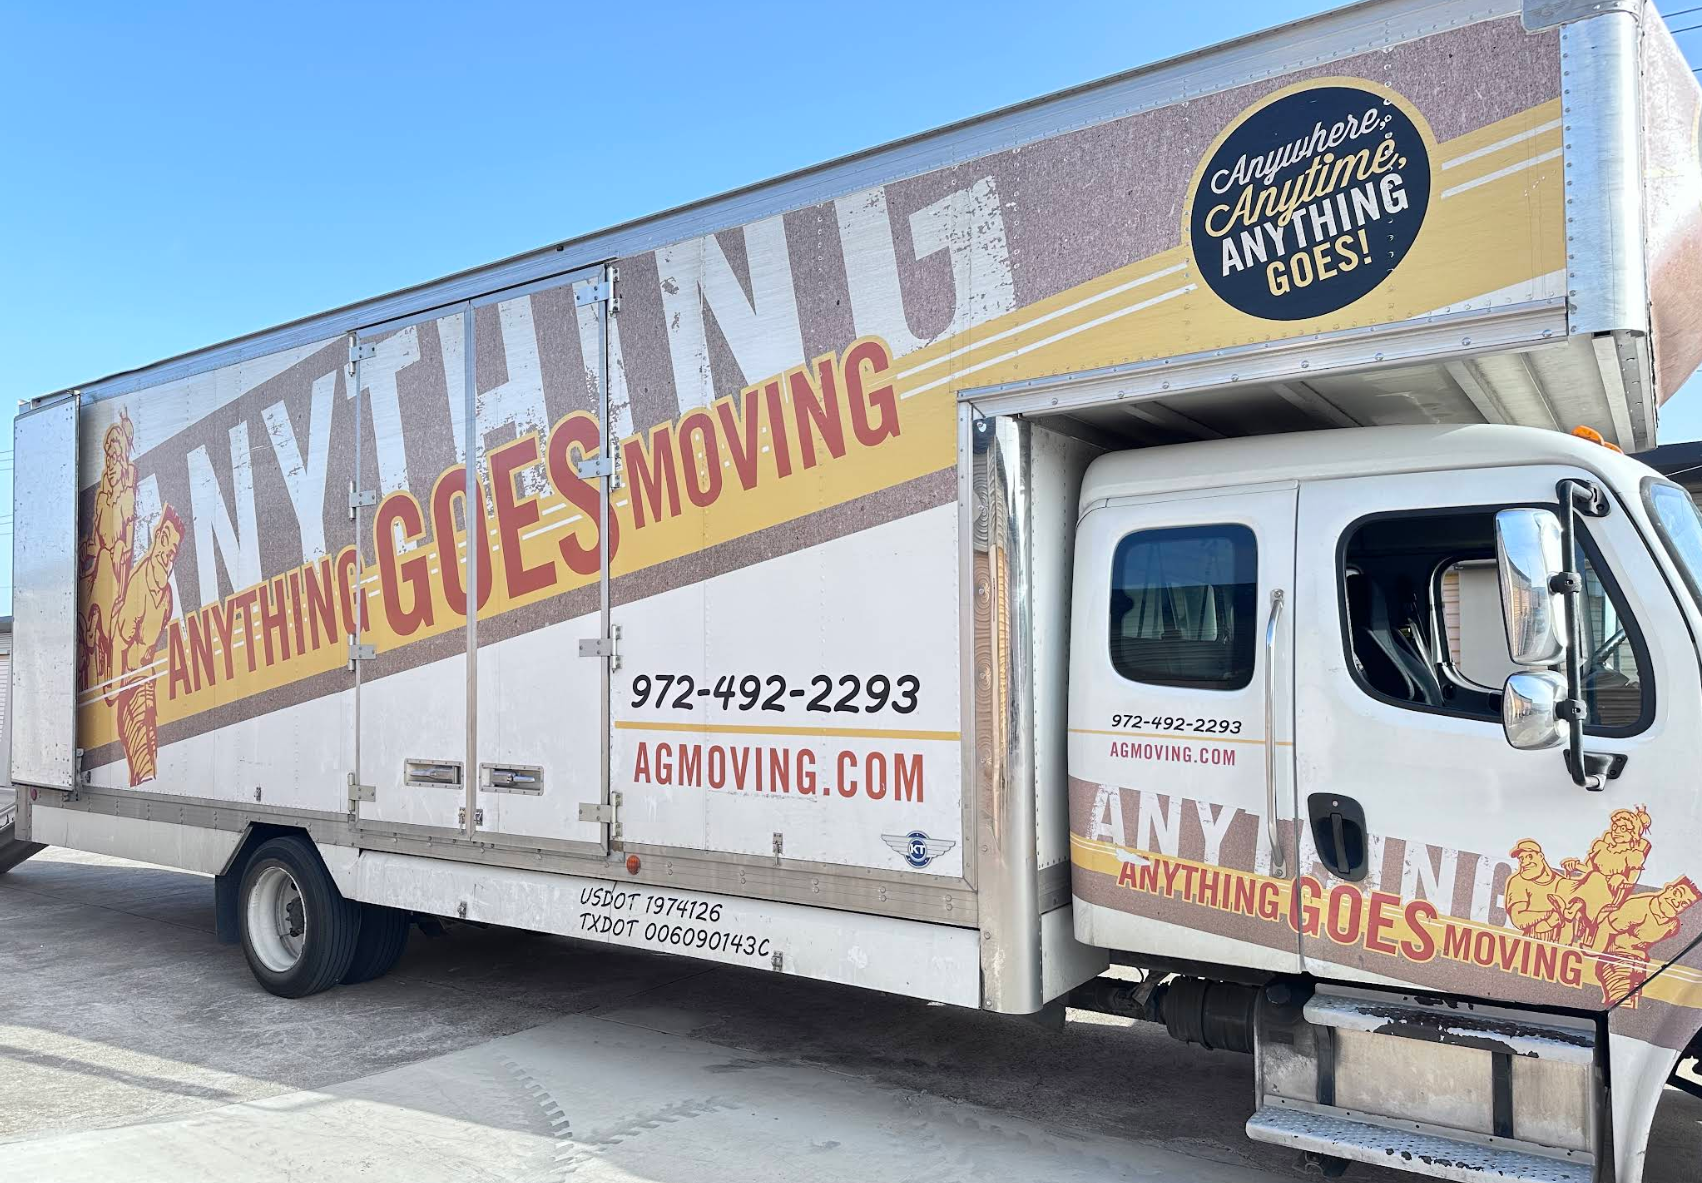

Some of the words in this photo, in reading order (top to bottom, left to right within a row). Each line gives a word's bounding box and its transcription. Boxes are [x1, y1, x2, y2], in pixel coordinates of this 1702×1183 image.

[1210, 108, 1386, 194] Anywhere,
[1205, 138, 1408, 237] Anytime,
[1222, 172, 1409, 277] ANYTHING
[1266, 228, 1373, 297] GOES!
[167, 549, 371, 700] ANYTHING
[376, 415, 620, 637] GOES
[623, 341, 901, 530] MOVING
[631, 674, 921, 714] 972-492-2293
[1111, 714, 1243, 735] 972-492-2293
[633, 741, 924, 803] AGMOVING.COM
[1110, 741, 1236, 766] AGMOVING.COM
[909, 843, 926, 855] KT
[579, 912, 640, 937] TXDOT
[644, 922, 770, 957] 006090143C
[580, 887, 641, 911] USDOT
[645, 895, 723, 923] 1974126
[1118, 858, 1280, 921] ANYTHING
[1288, 875, 1438, 963] GOES
[1444, 927, 1583, 989] MOVING
